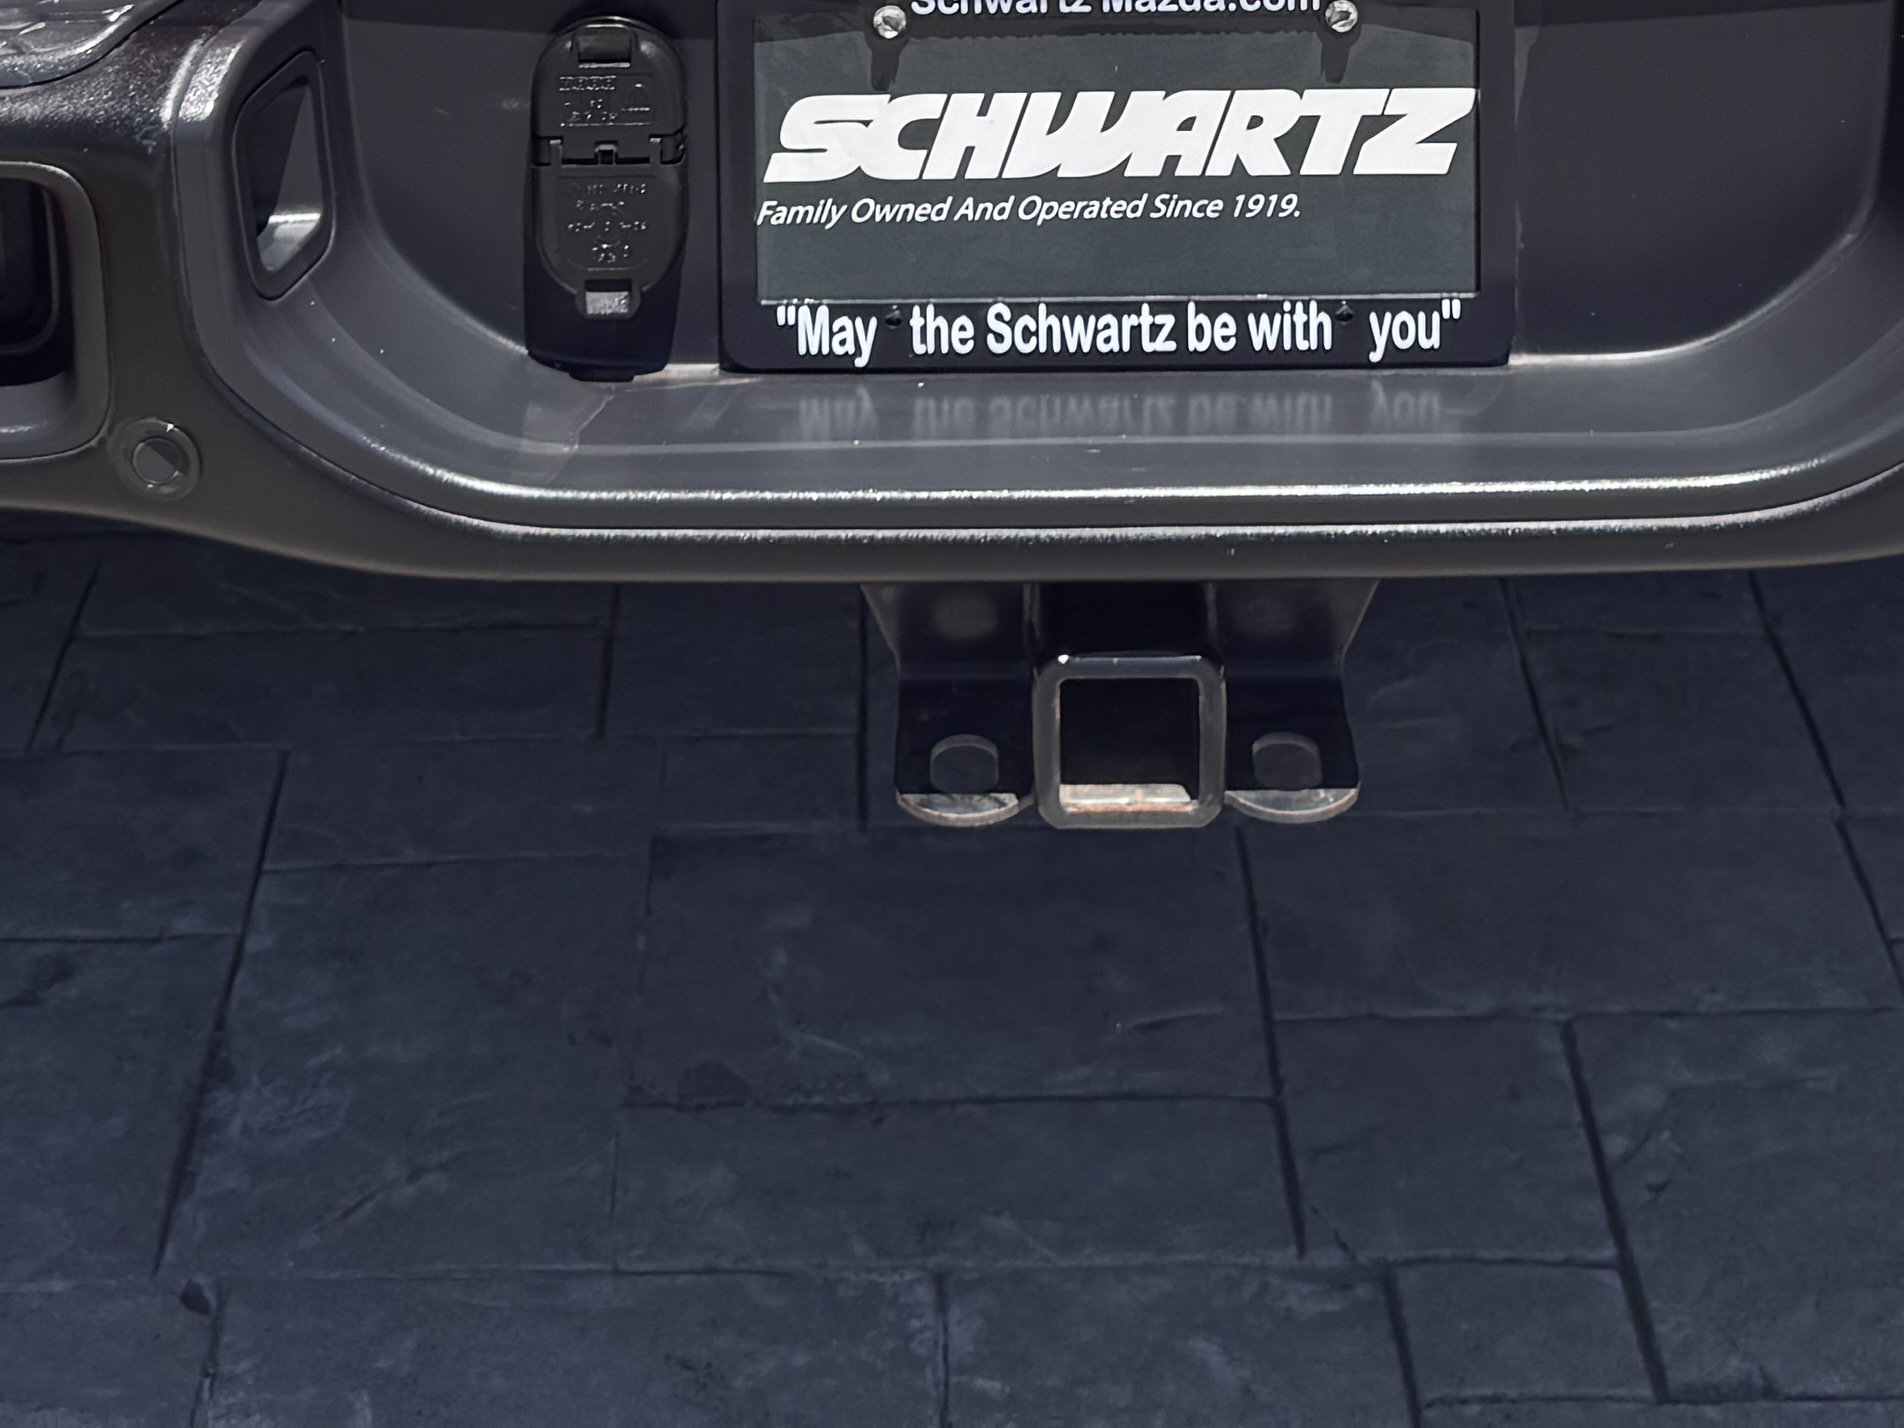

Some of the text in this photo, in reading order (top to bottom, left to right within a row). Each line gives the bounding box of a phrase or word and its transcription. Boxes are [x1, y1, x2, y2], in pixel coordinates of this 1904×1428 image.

[763, 87, 1476, 184] SCHWARTZ
[756, 192, 1301, 230] Family Owned And Operated Since 1919.
[776, 301, 1461, 368] "May the Schwartz be with you"
